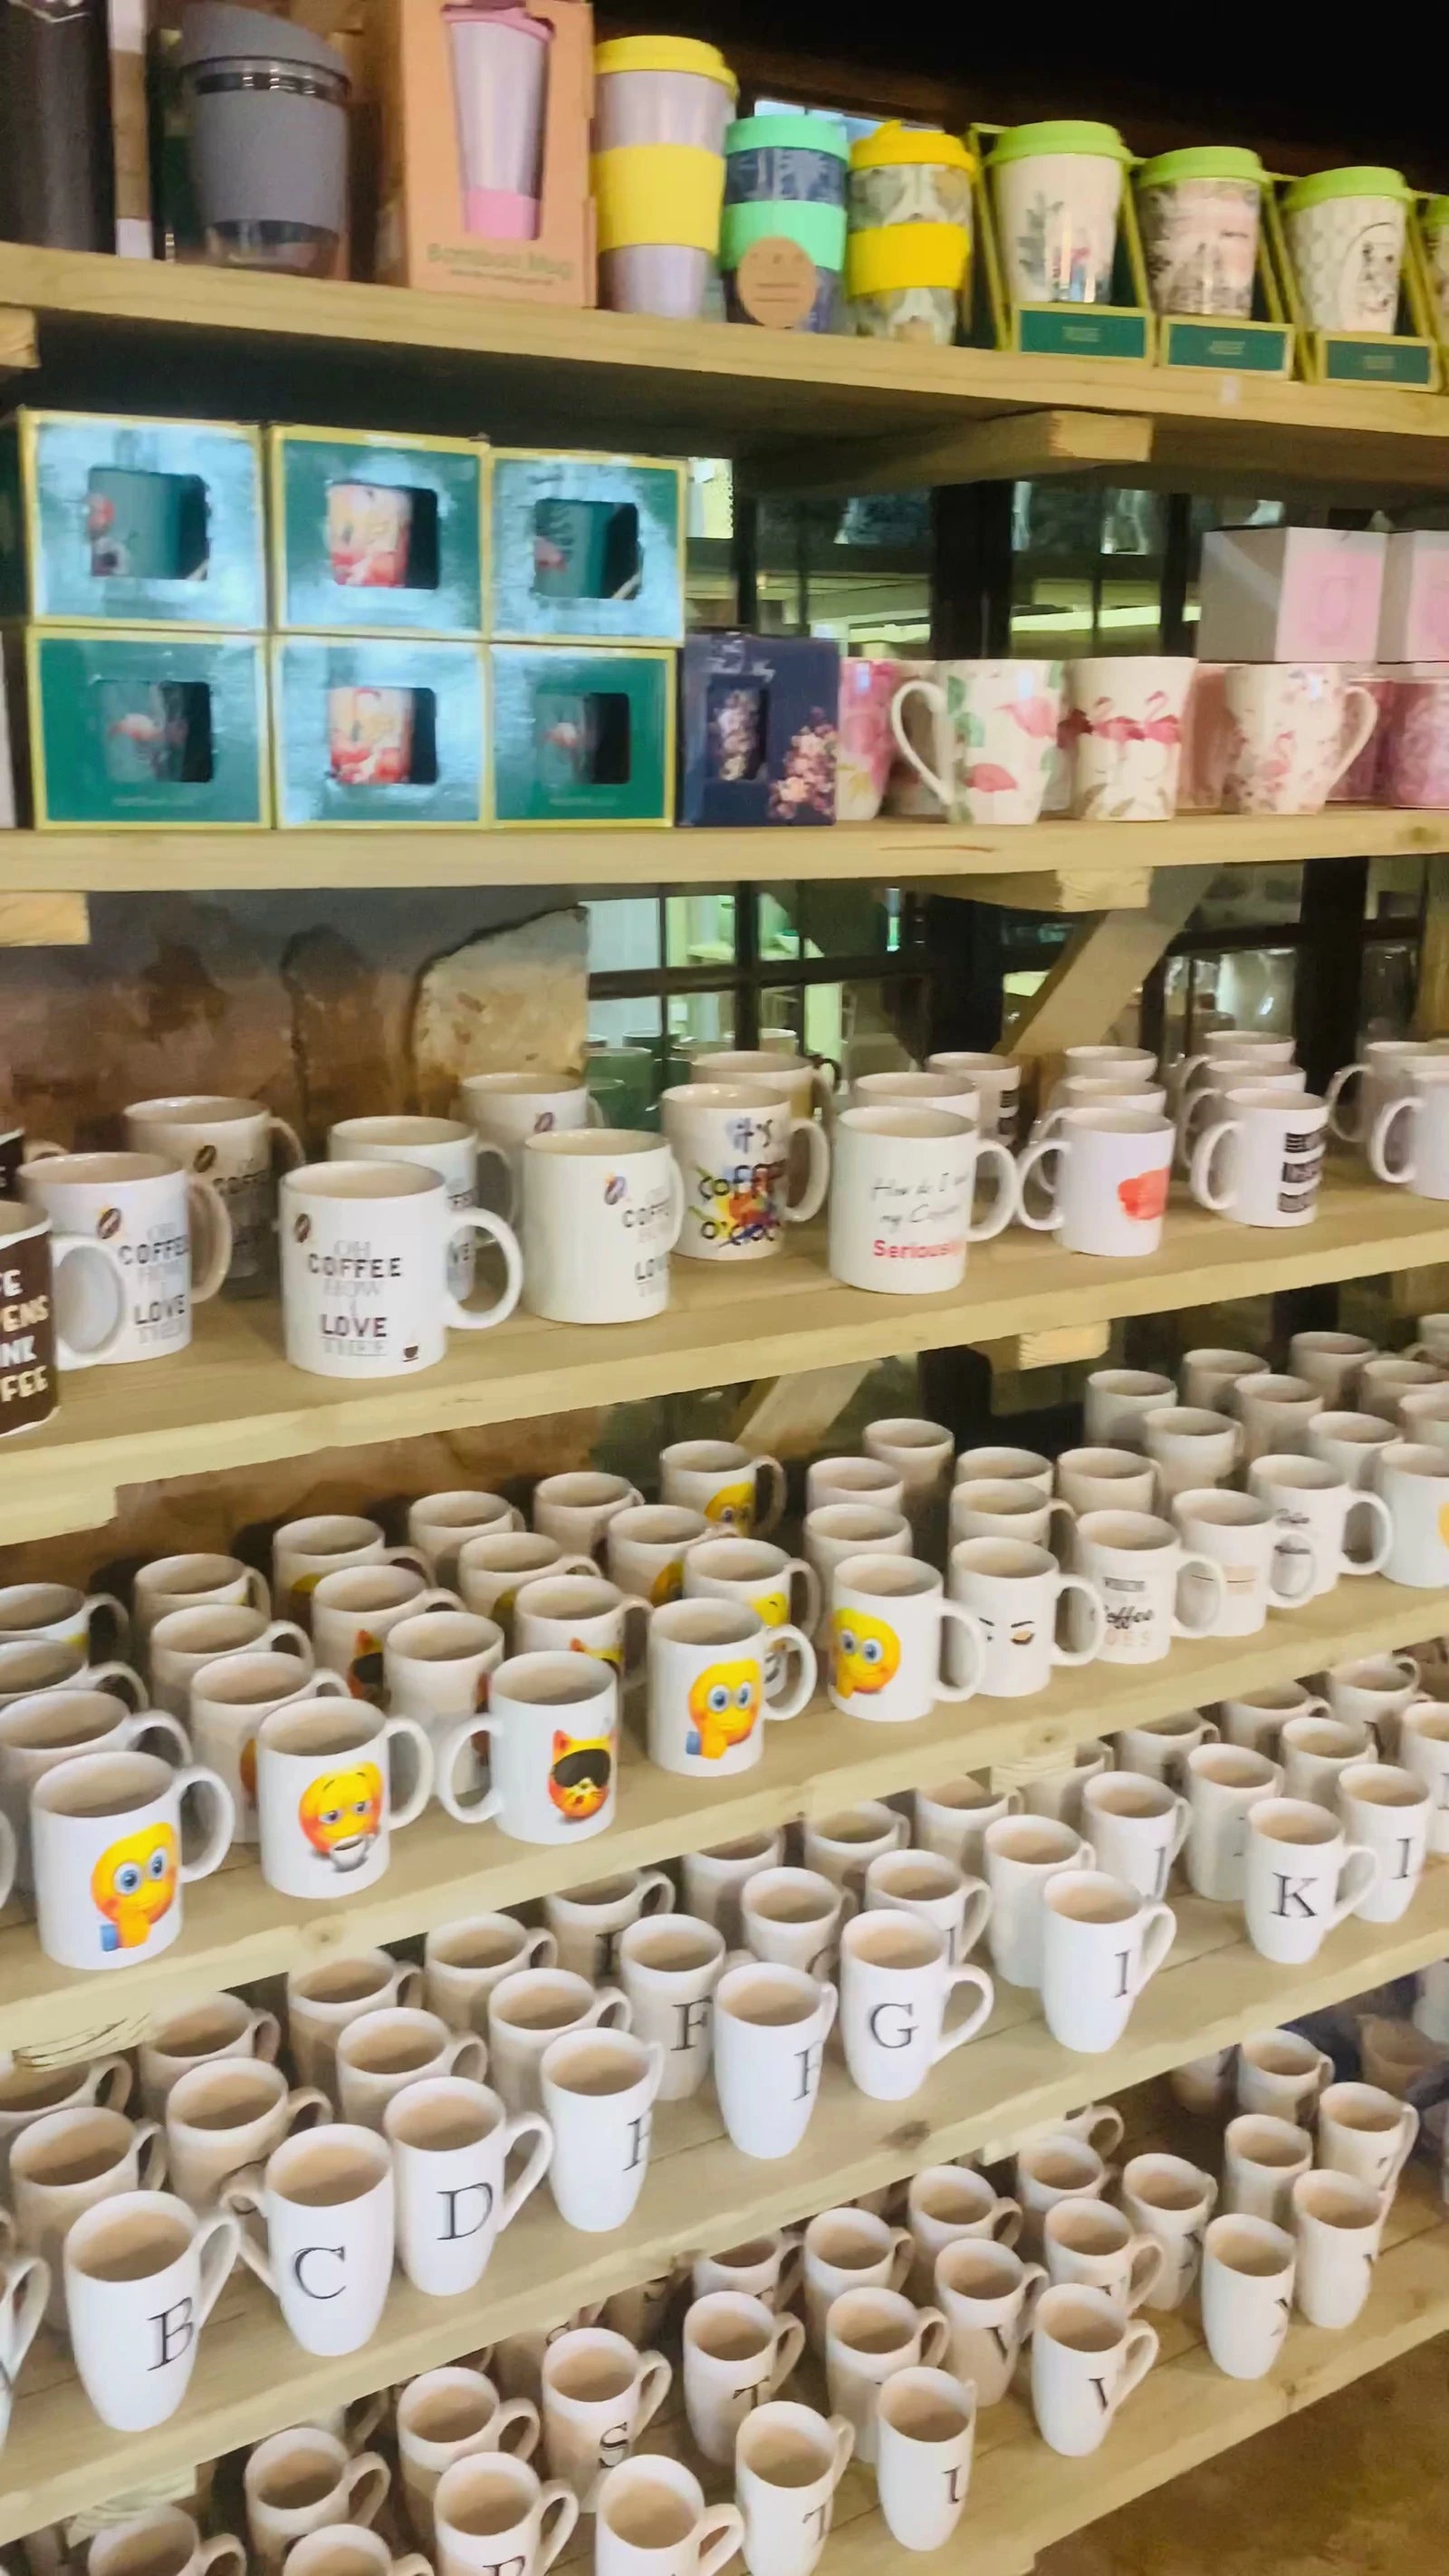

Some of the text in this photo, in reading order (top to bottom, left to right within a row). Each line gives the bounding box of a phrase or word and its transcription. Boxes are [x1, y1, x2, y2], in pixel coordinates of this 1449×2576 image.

[308, 1253, 402, 1279] COFFEE
[333, 1239, 371, 1259] OH
[321, 1313, 388, 1338] LOVE
[1270, 1870, 1319, 1918] K
[670, 1994, 715, 2052] F
[869, 2002, 920, 2050] G
[436, 2181, 494, 2242] D
[291, 2244, 348, 2301] C
[147, 2296, 195, 2372] B
[598, 2420, 631, 2469] S
